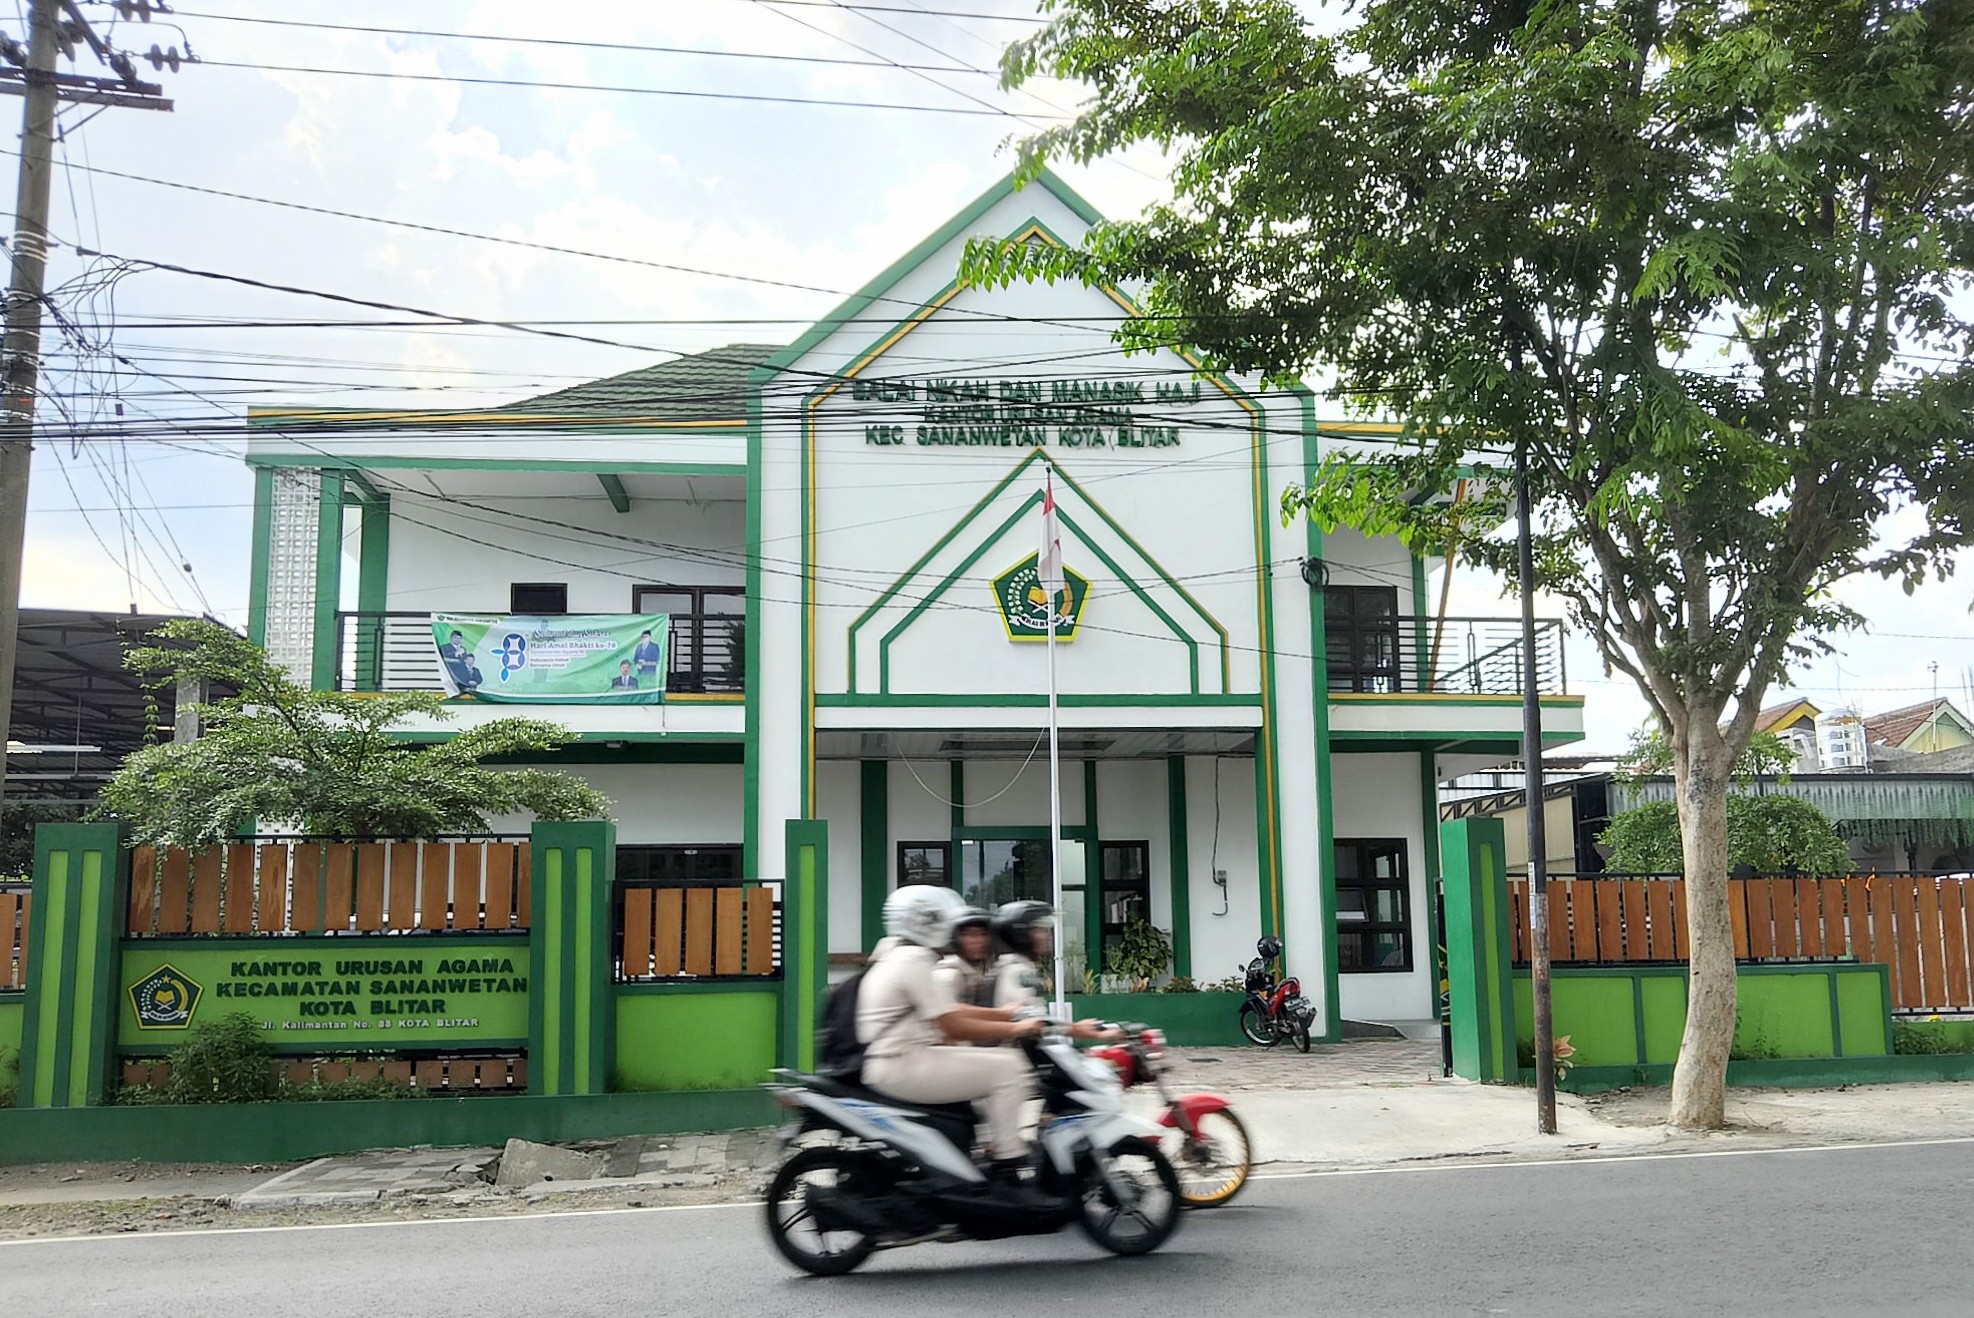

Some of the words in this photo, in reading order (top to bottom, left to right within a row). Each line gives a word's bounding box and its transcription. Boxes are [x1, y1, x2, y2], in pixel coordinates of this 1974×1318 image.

[999, 379, 1042, 402] DAN
[1051, 380, 1145, 402] MANASIK
[865, 424, 904, 446] KEC
[916, 425, 1047, 447] SANANWETAN
[1058, 426, 1106, 447] KOTA
[1117, 427, 1181, 448] BLITAR
[569, 641, 595, 649] Bhakti
[230, 961, 322, 977] KANTOR
[335, 959, 423, 976] URUSAN
[436, 958, 514, 974] AGAMA
[216, 980, 361, 998] KECAMATAN
[369, 977, 528, 995] SANANWETAN
[299, 1000, 357, 1016] KOTA
[370, 999, 446, 1015] BLITAR
[261, 1022, 276, 1030] Jl.
[282, 1020, 348, 1030] Kalimantan
[353, 1020, 372, 1029] No.
[398, 1018, 430, 1028] KOTA
[436, 1018, 479, 1027] BLITAR
